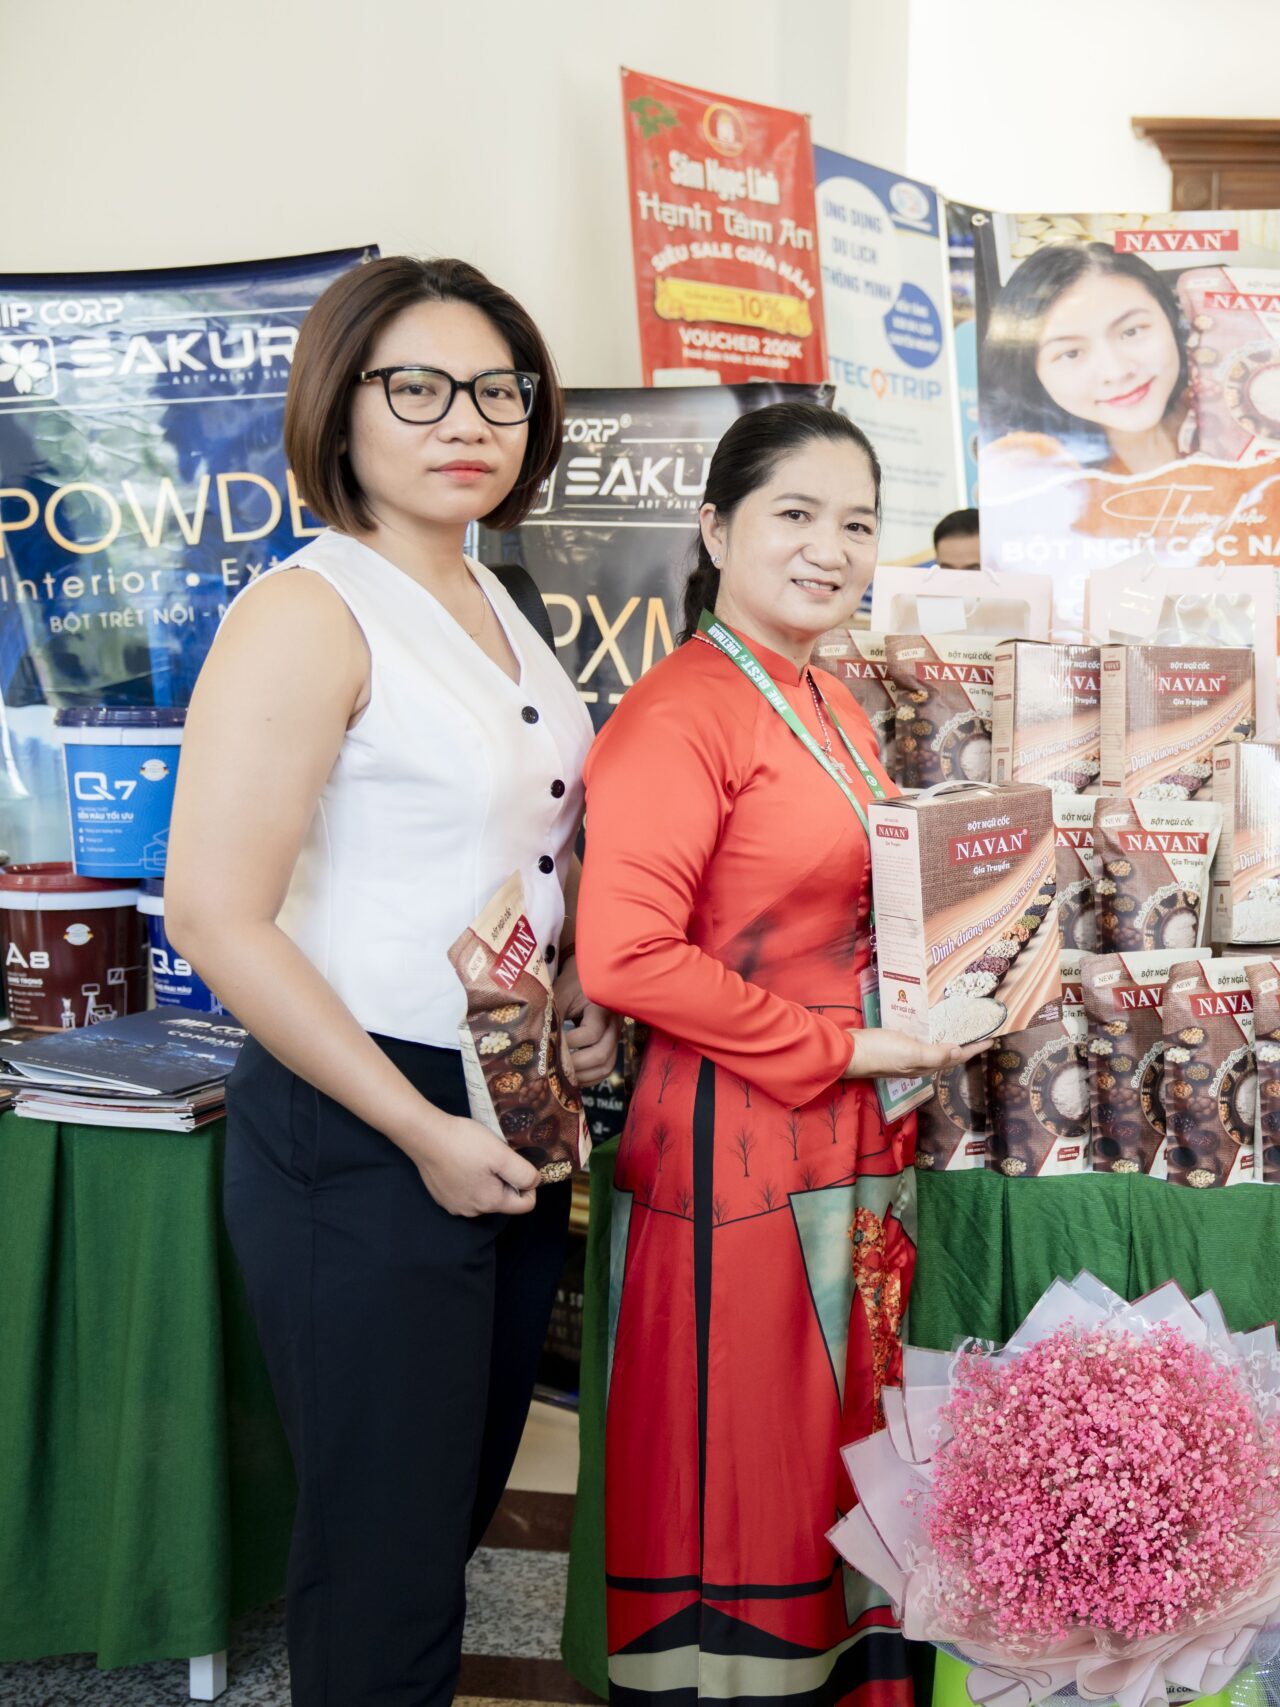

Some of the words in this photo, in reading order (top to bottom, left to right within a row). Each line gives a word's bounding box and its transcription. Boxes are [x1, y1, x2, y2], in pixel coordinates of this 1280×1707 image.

[637, 190, 712, 232] Hạnh
[717, 205, 772, 244] Tâm
[780, 218, 813, 251] An
[690, 242, 733, 259] SALE
[40, 299, 124, 326] CORP
[678, 326, 760, 354] VOUCHER
[1002, 538, 1074, 565] BỘT
[1166, 526, 1238, 557] CỐC
[2, 568, 162, 603] Interior
[50, 611, 91, 634] BỘT
[99, 608, 145, 629] TRÉT
[153, 601, 195, 626] NỘI
[1159, 677, 1221, 692] NAVAN
[74, 771, 137, 801] Q7
[878, 826, 906, 838] NAVAN
[967, 820, 984, 831] BỘT
[997, 816, 1010, 827] CỐC
[956, 833, 1024, 861] NAVAN
[1126, 834, 1200, 852] NAVAN
[973, 865, 987, 875] Gia
[987, 862, 1010, 873] Truyền
[5, 942, 50, 969] A8
[150, 947, 192, 977] Q9
[496, 929, 537, 990] NAVAN
[931, 939, 955, 965] Dinh
